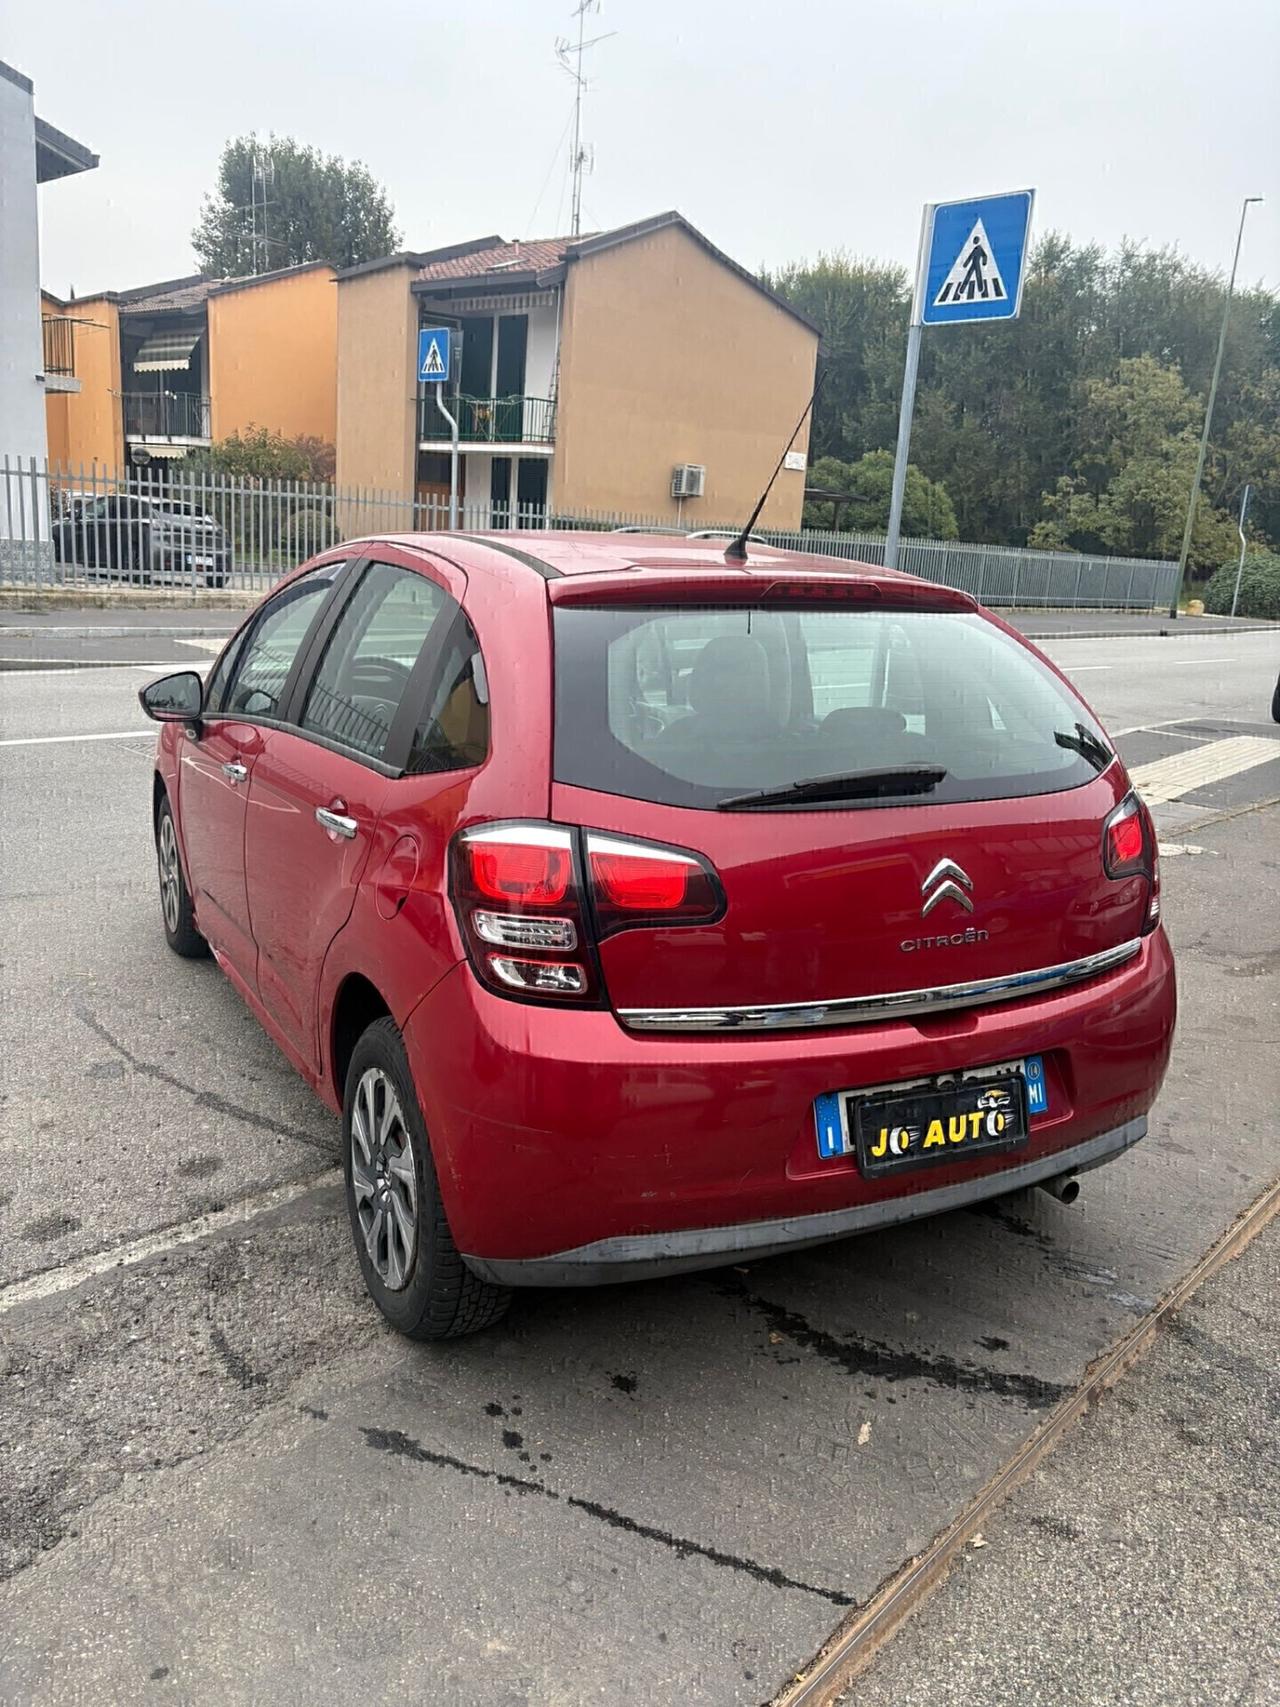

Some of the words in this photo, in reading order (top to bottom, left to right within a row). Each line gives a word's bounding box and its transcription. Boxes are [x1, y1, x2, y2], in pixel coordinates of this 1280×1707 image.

[1028, 1082, 1043, 1105] MI
[827, 1126, 834, 1149] I
[922, 1109, 1005, 1148] AUTO
